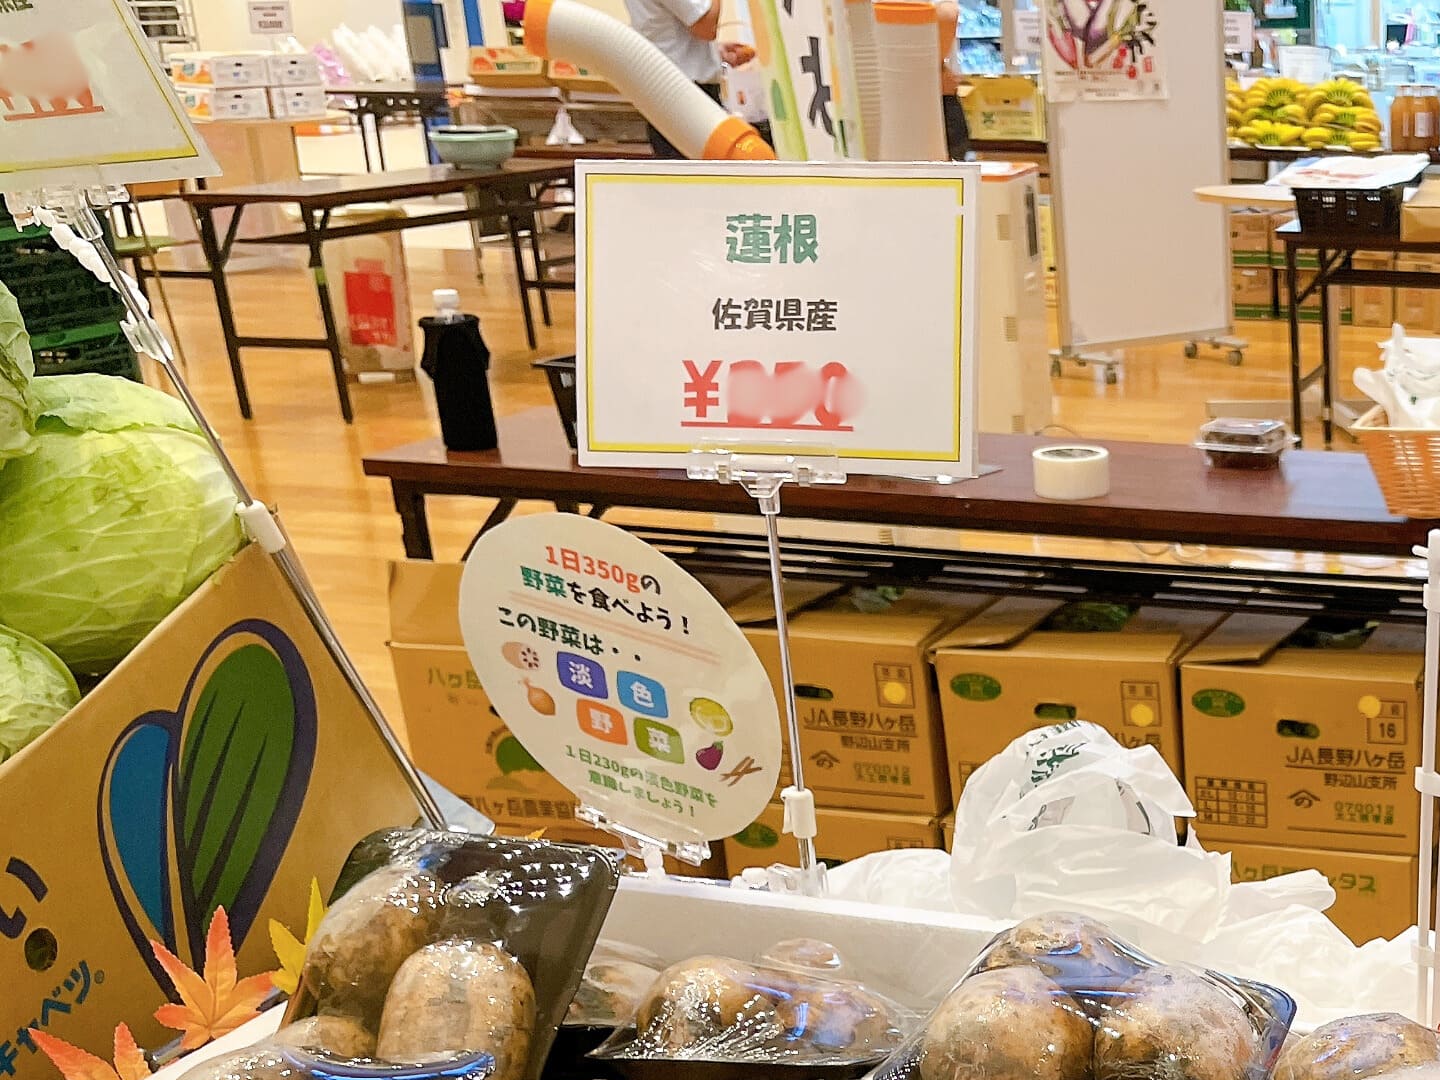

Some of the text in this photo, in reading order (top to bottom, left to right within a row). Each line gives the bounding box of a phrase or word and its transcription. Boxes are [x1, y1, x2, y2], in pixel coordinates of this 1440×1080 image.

[726, 213, 819, 264] 蓮根
[712, 298, 838, 332] 佐賀県産
[544, 544, 662, 595] 1日350gの
